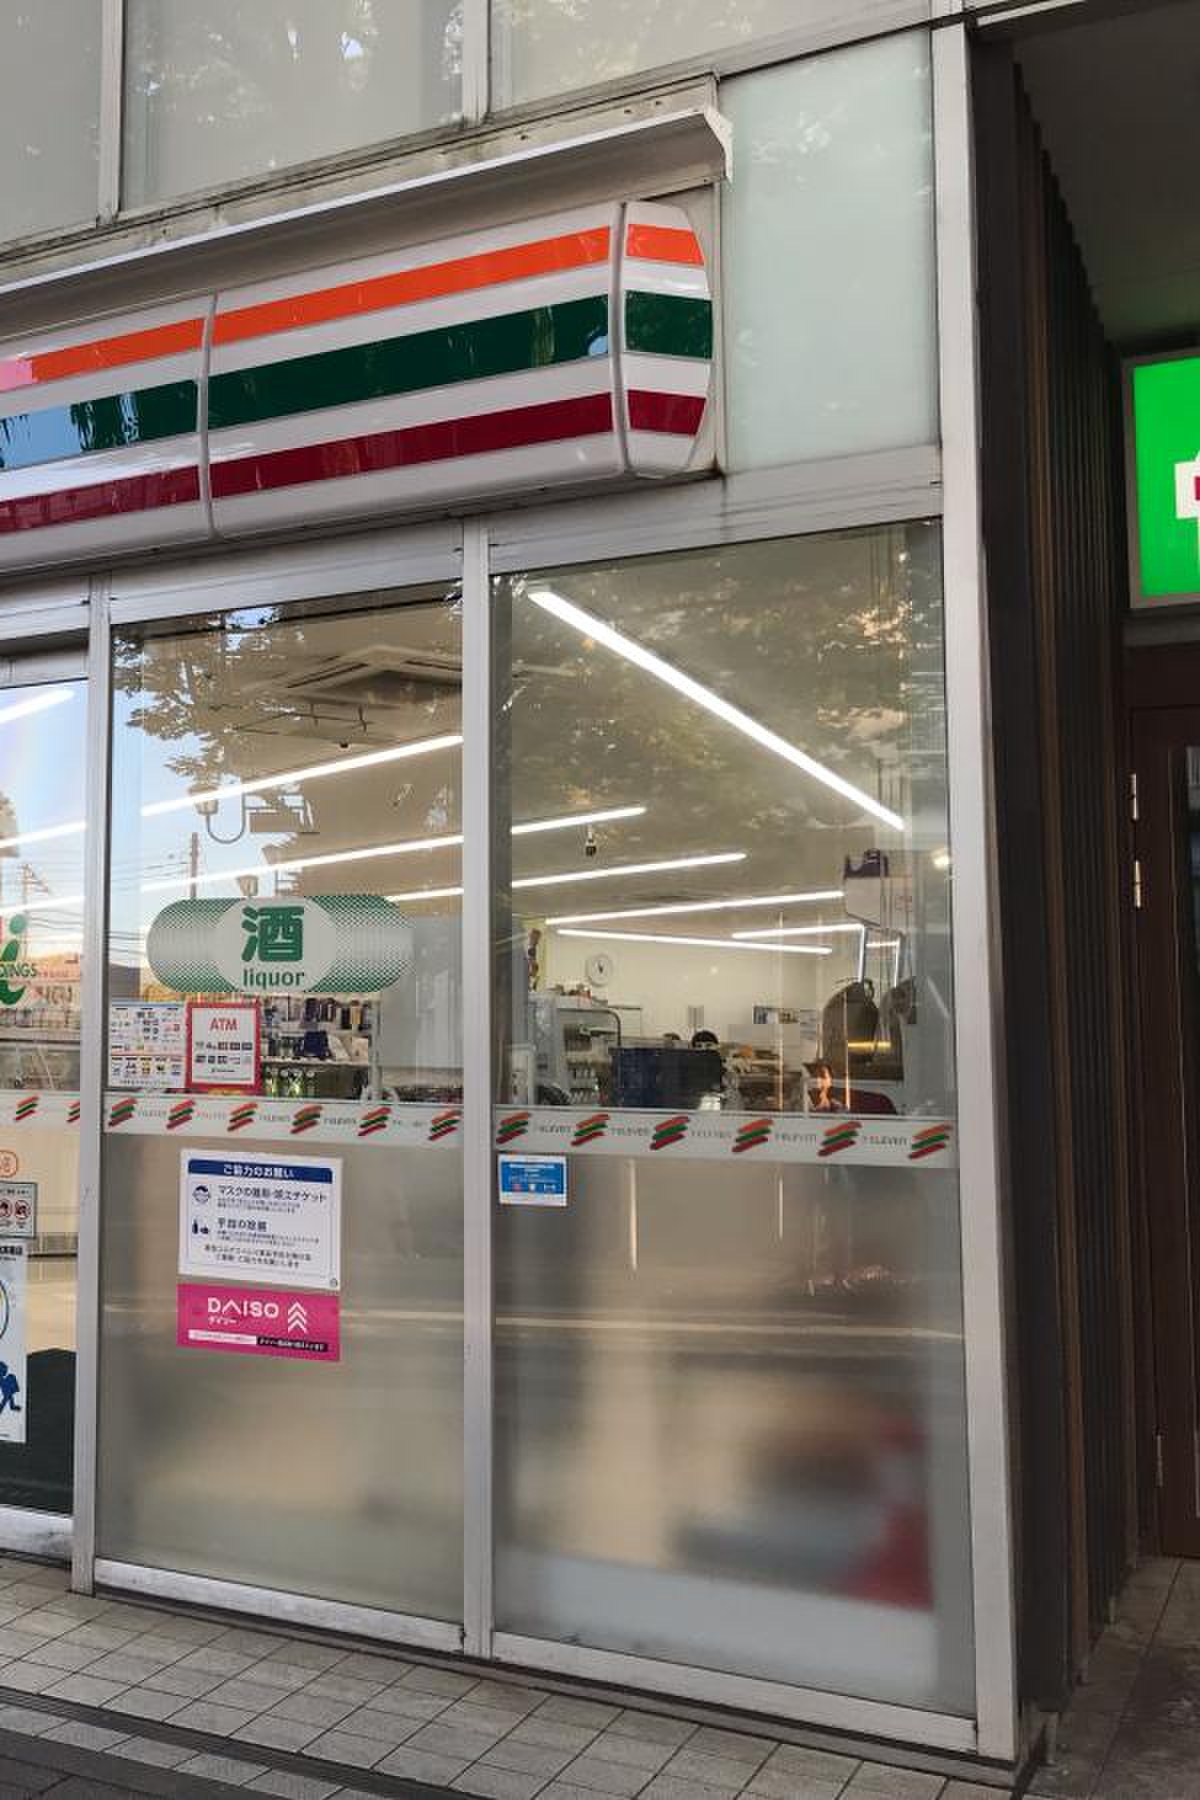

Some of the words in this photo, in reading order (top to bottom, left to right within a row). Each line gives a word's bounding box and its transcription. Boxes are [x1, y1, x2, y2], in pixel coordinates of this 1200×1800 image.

[241, 905, 305, 963] 酒
[243, 969, 305, 990] liquor
[209, 1017, 238, 1031] ATM
[207, 1297, 280, 1319] DAISO
